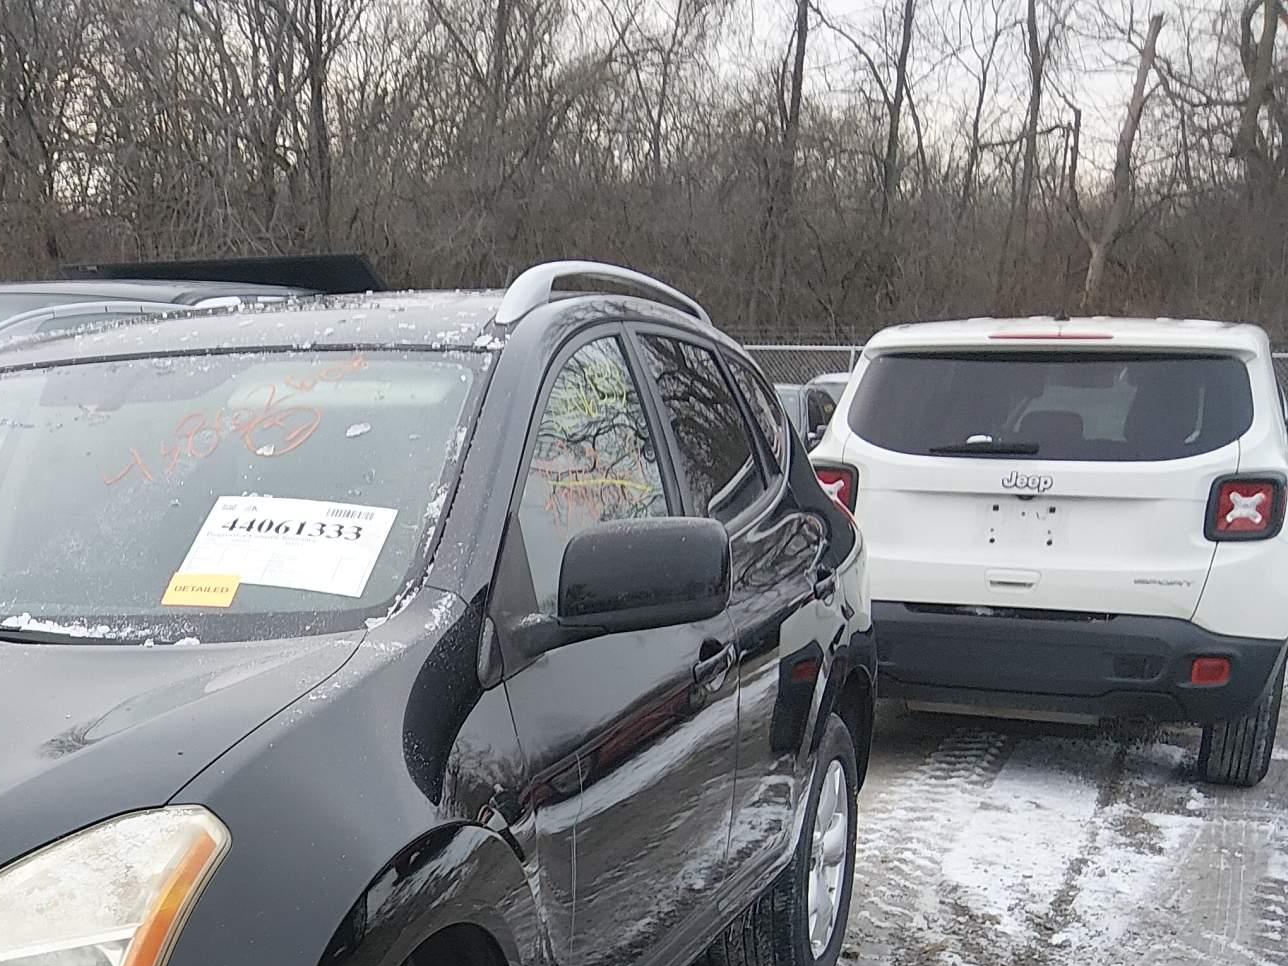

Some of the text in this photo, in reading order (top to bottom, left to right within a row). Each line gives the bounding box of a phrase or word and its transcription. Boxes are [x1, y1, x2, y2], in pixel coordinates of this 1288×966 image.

[1001, 471, 1053, 492] Jeep
[221, 517, 364, 542] 44061333
[174, 585, 230, 594] DETAILED
